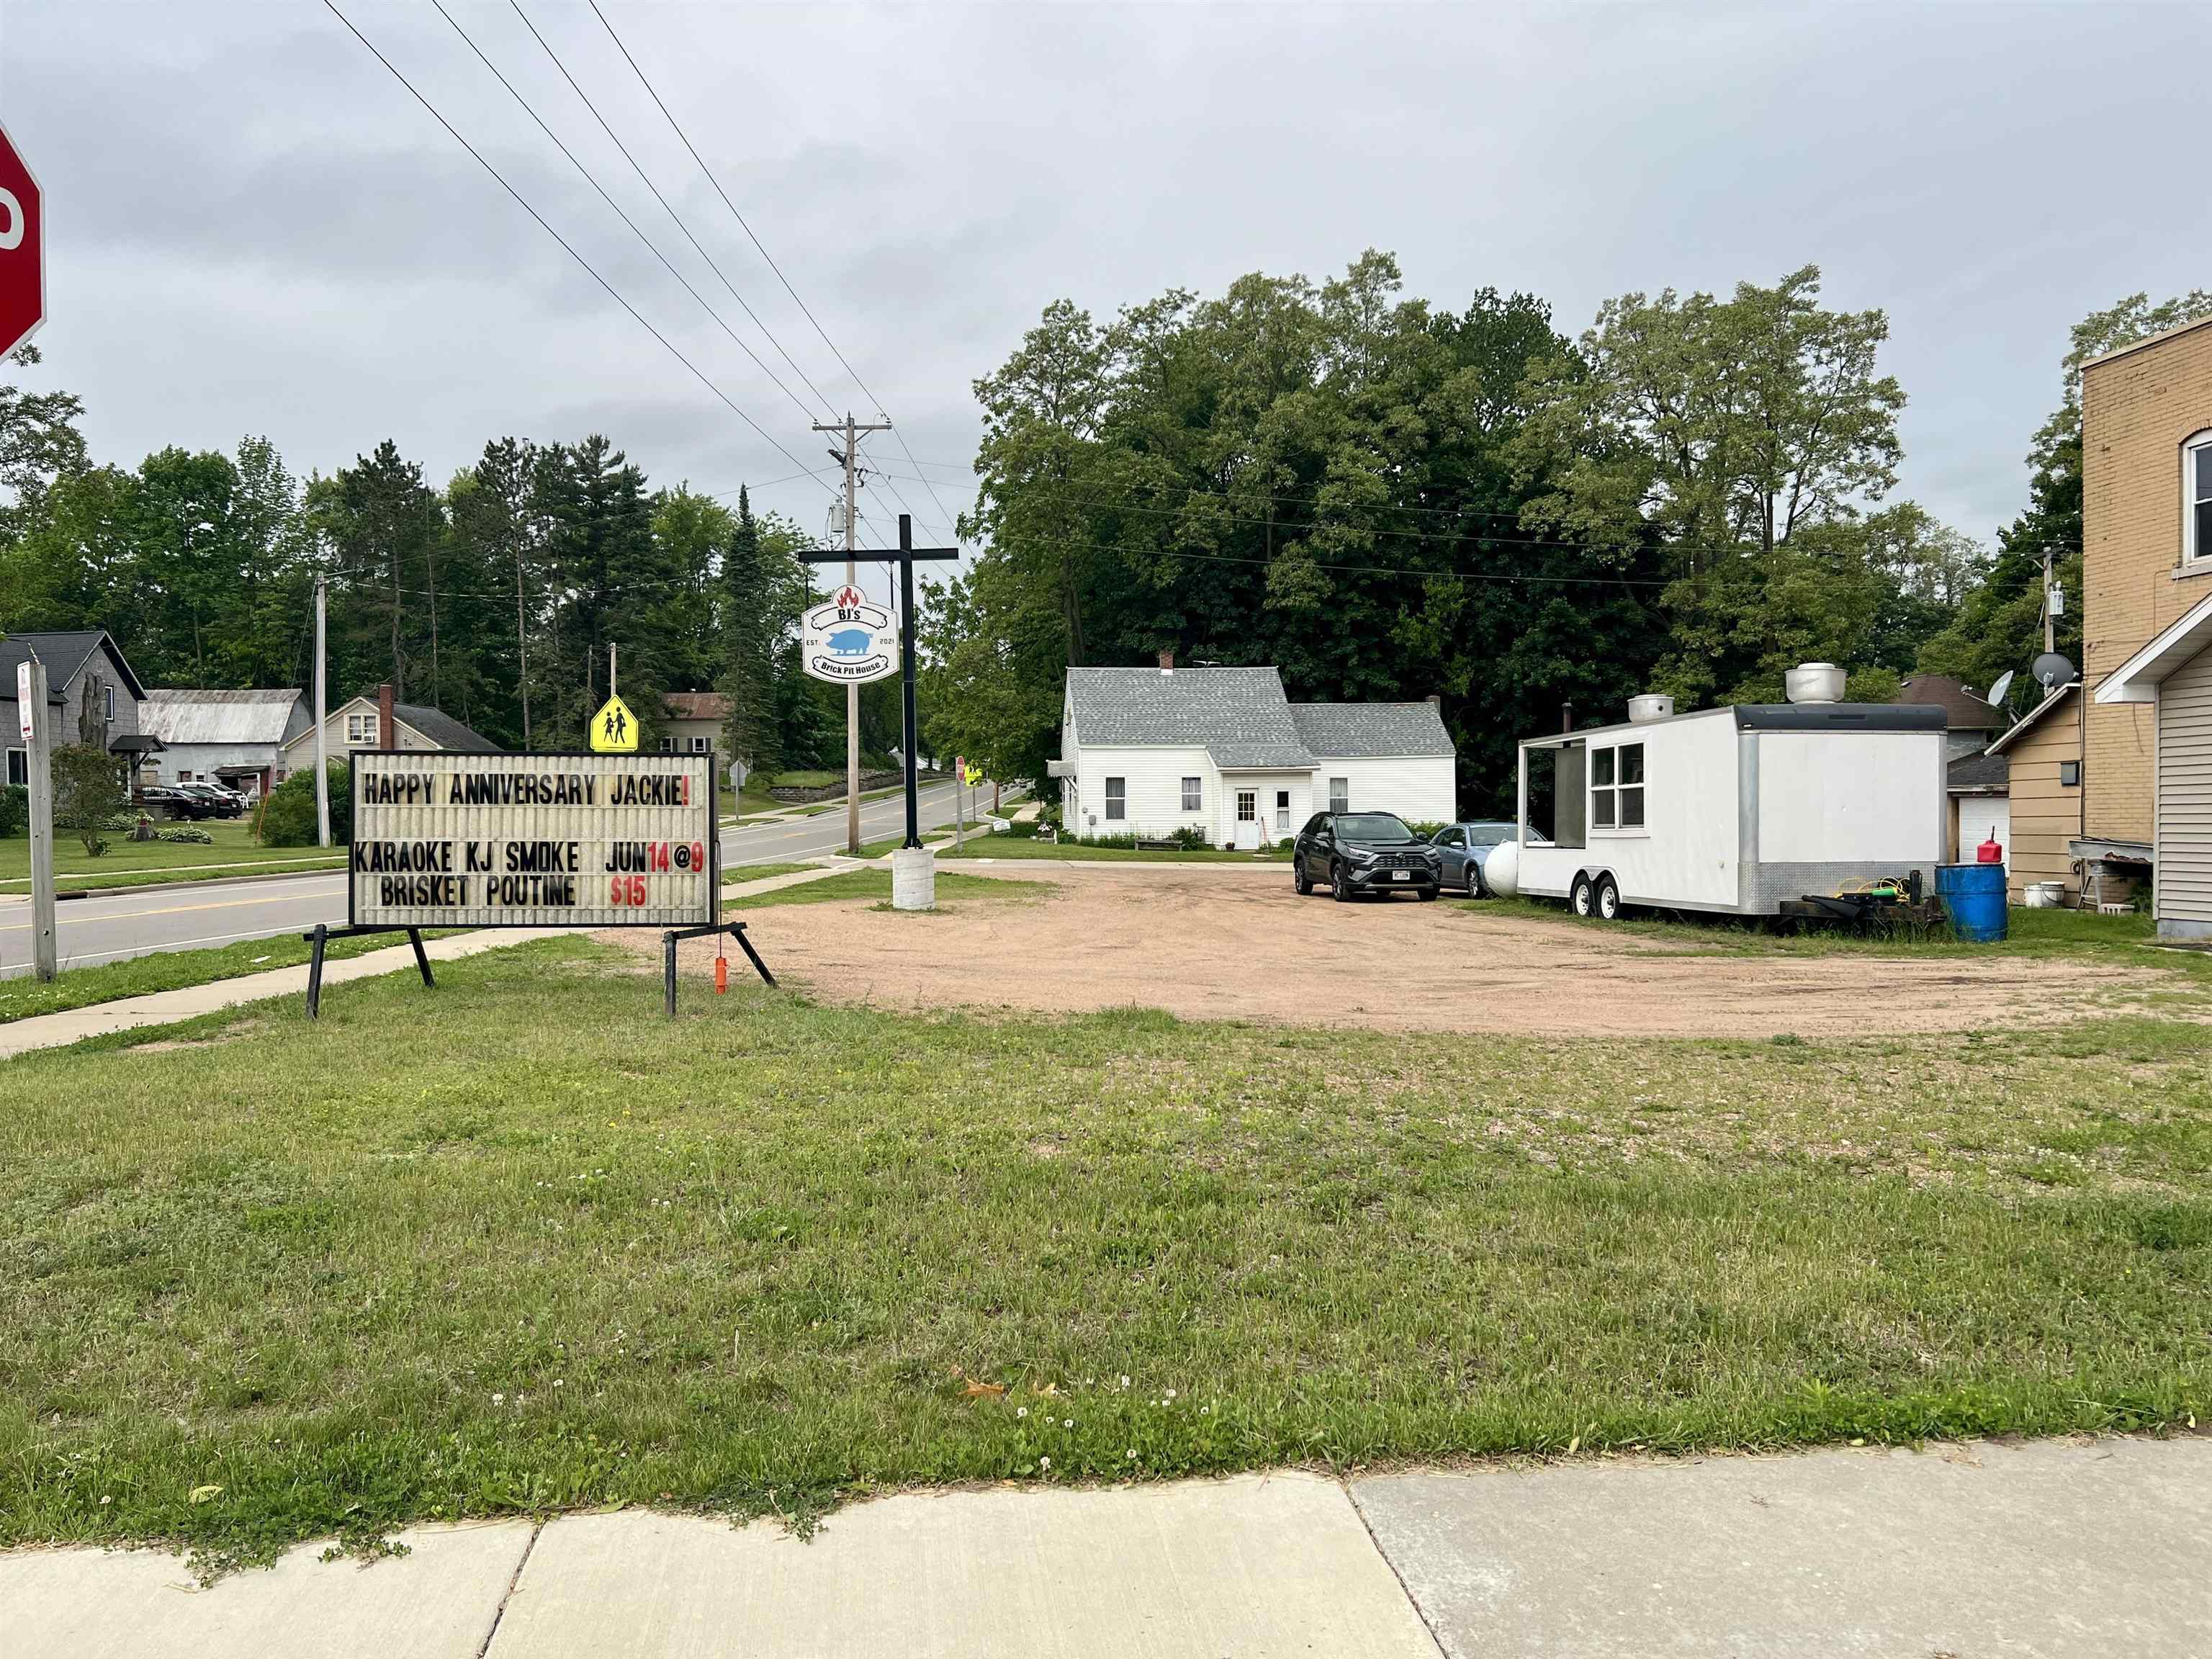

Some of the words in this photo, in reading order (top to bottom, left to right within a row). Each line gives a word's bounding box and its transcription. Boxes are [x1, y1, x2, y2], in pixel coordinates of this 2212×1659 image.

[837, 608, 861, 620] BJ's
[821, 661, 842, 674] Brick
[855, 662, 881, 674] House
[365, 773, 434, 804] HAPPY
[449, 773, 596, 805] ANNIVERSARY
[611, 774, 689, 806] JACKIE!
[354, 841, 451, 872] KARAOKE
[467, 841, 493, 872] KJ
[506, 841, 579, 872] SMOKE
[381, 875, 468, 907] BRISKET
[487, 875, 575, 906] POUTINE
[611, 875, 646, 907] $15
